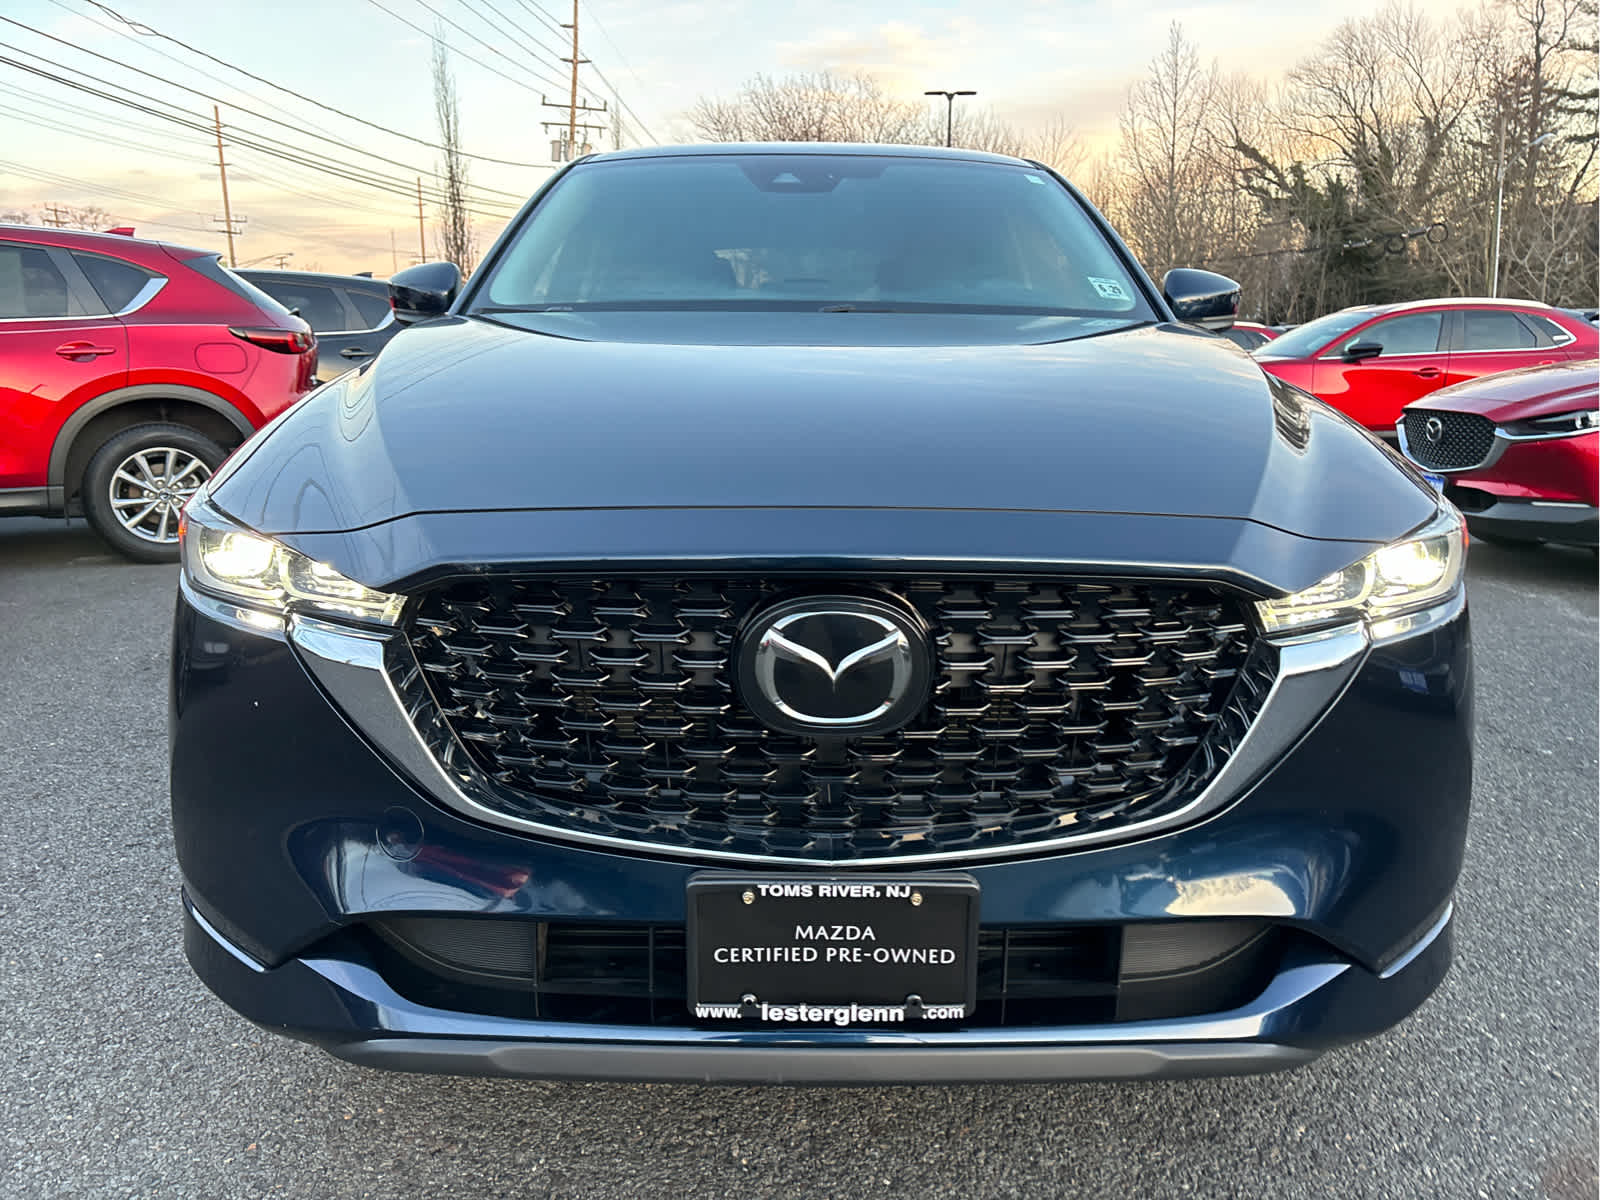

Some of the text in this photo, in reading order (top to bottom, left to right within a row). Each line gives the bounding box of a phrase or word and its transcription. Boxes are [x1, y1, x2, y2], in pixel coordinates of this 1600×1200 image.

[757, 884, 911, 898] TOMS RIVER, NJ
[795, 925, 876, 940] MAZDA
[714, 947, 956, 964] CERTIFIED PRE-OWNED
[695, 1002, 964, 1026] www. lesterglenn .com
